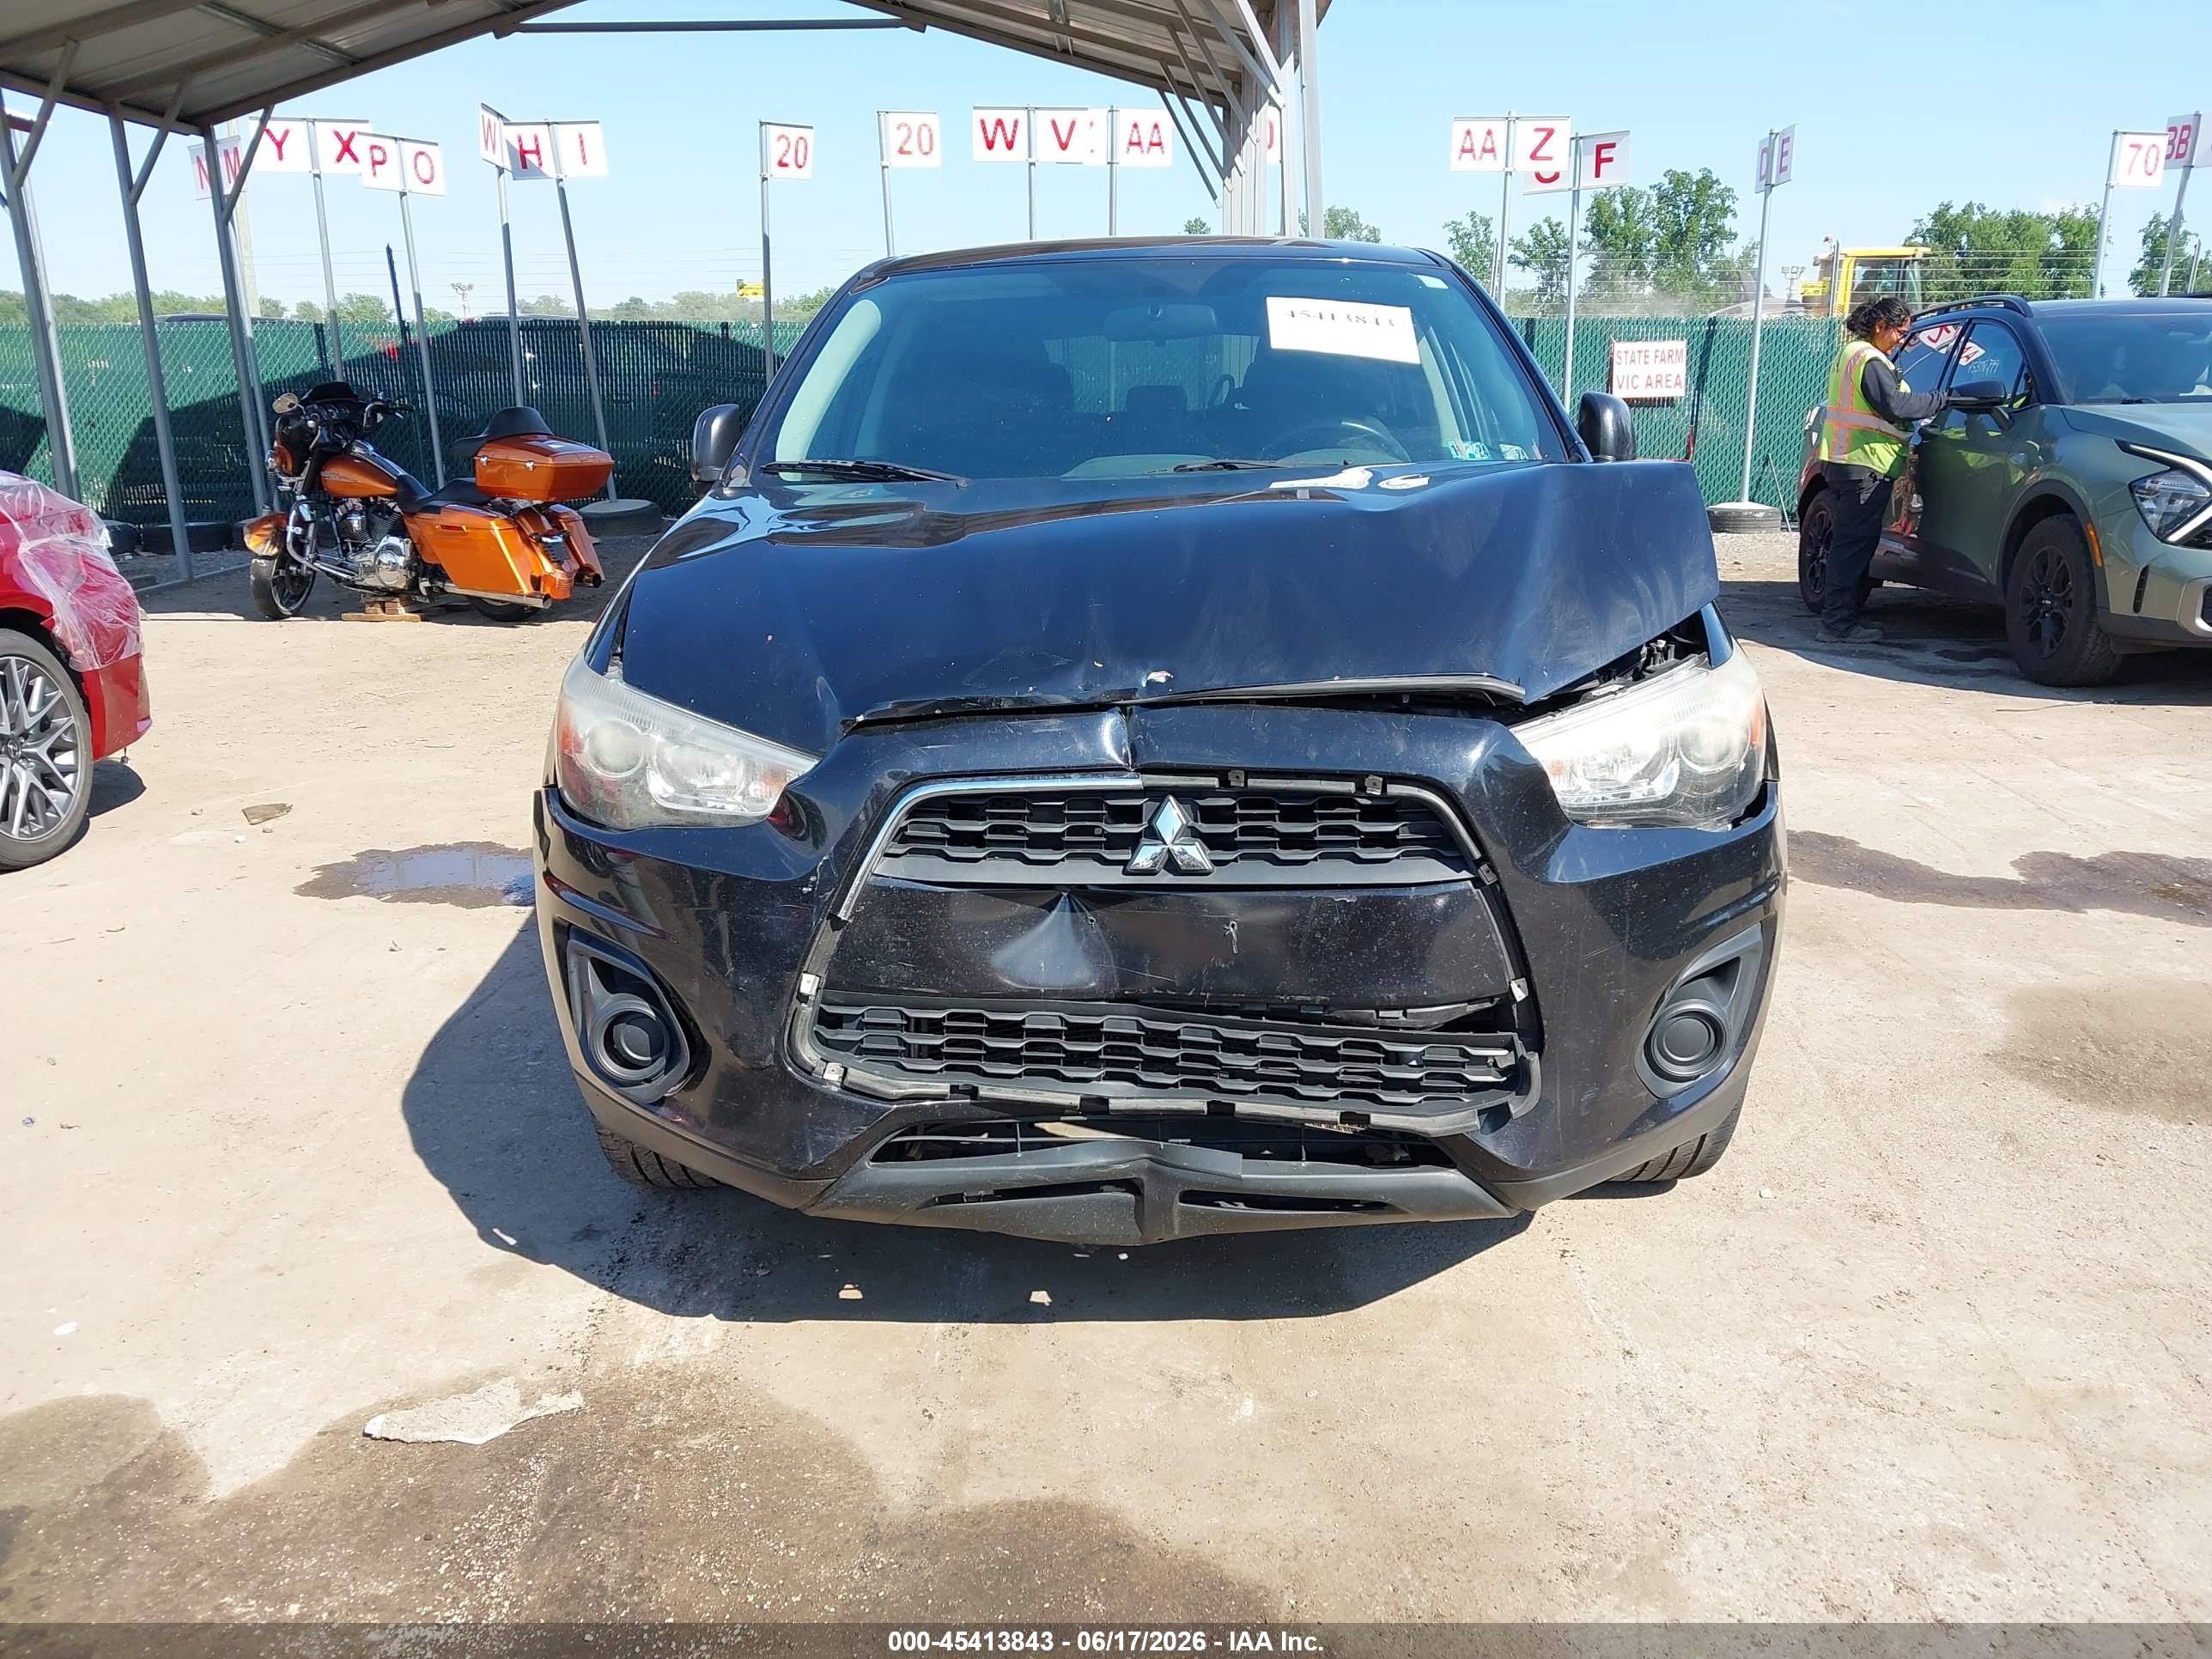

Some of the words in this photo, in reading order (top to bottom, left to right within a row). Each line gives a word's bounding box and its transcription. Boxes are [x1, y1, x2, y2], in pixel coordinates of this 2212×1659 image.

[261, 125, 290, 162] Y
[332, 129, 360, 164] X
[482, 113, 496, 155] W
[517, 133, 544, 170] H
[776, 133, 808, 170] 20
[896, 122, 934, 156] 20
[979, 117, 1020, 152] W
[1050, 118, 1078, 152] V
[1125, 121, 1165, 155] AA
[1458, 128, 1498, 161] AA
[1528, 126, 1556, 161] Z
[222, 146, 241, 184] M
[369, 143, 388, 178] P
[1594, 142, 1617, 179] F
[1779, 137, 1791, 173] E
[2128, 143, 2161, 177] 70
[1616, 349, 1650, 366] STATE
[1654, 348, 1684, 365] FARM
[1616, 374, 1639, 390] VIC
[1644, 374, 1683, 389] AREA
